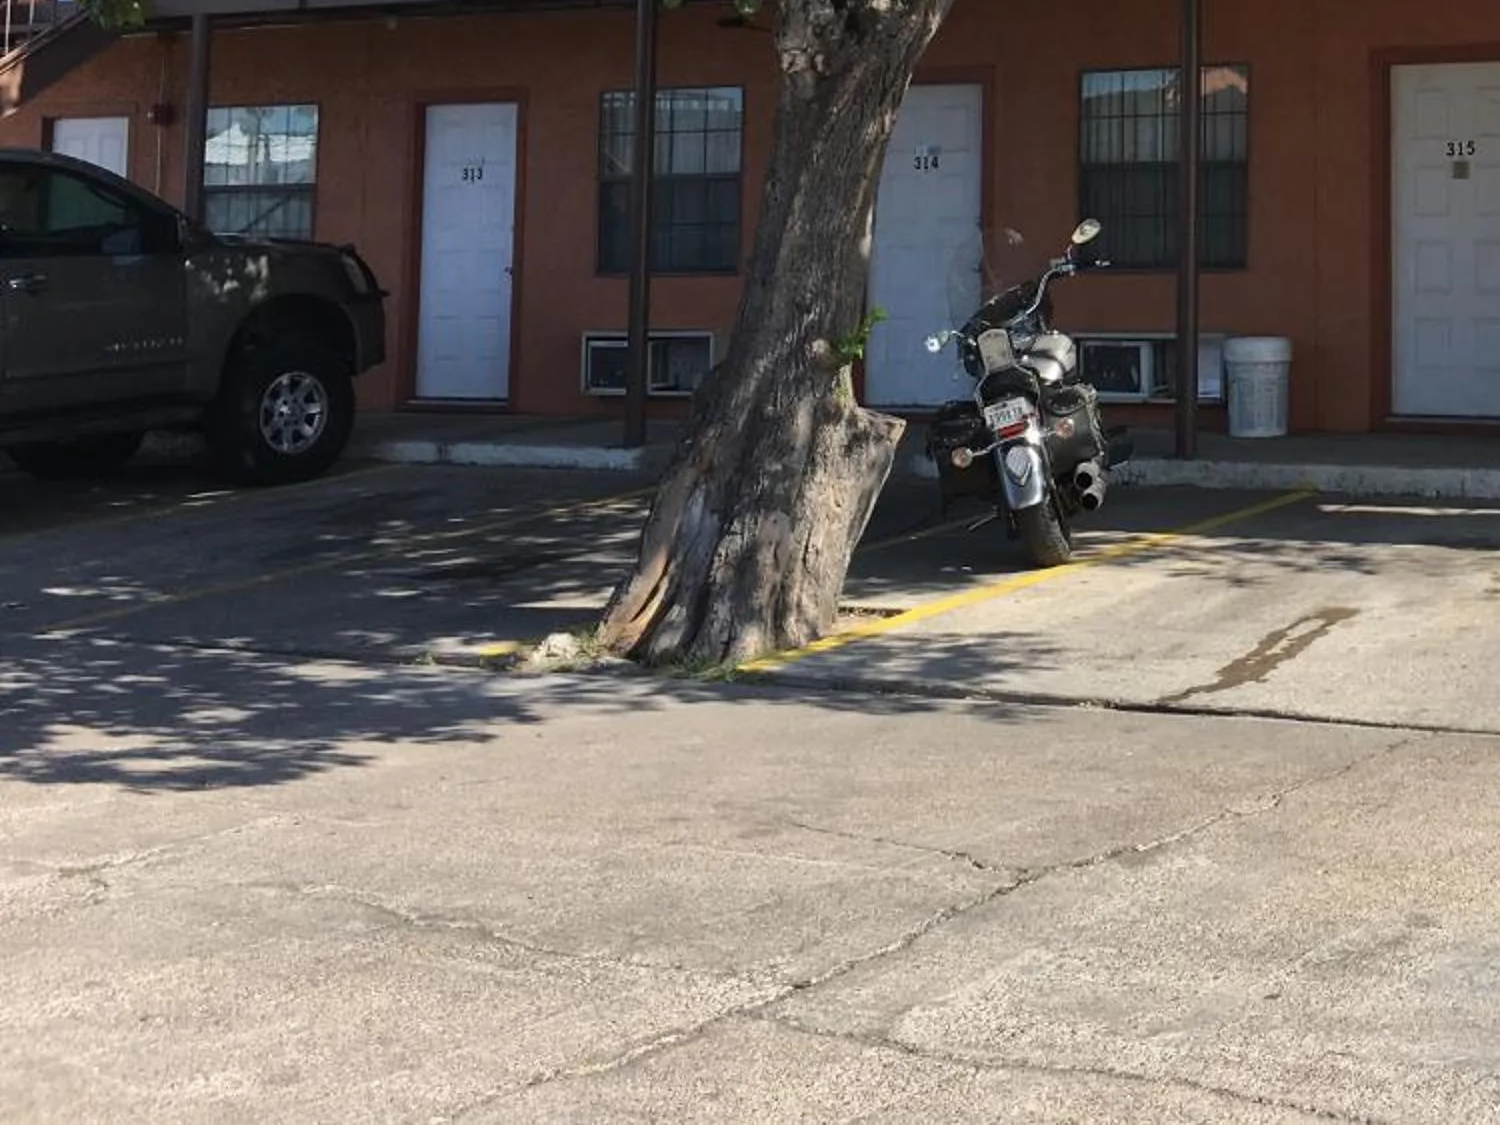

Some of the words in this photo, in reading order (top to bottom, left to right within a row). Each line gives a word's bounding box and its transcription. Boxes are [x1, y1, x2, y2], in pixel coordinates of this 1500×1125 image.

[1446, 140, 1476, 156] 315
[913, 155, 940, 172] 314
[462, 167, 484, 182] 313
